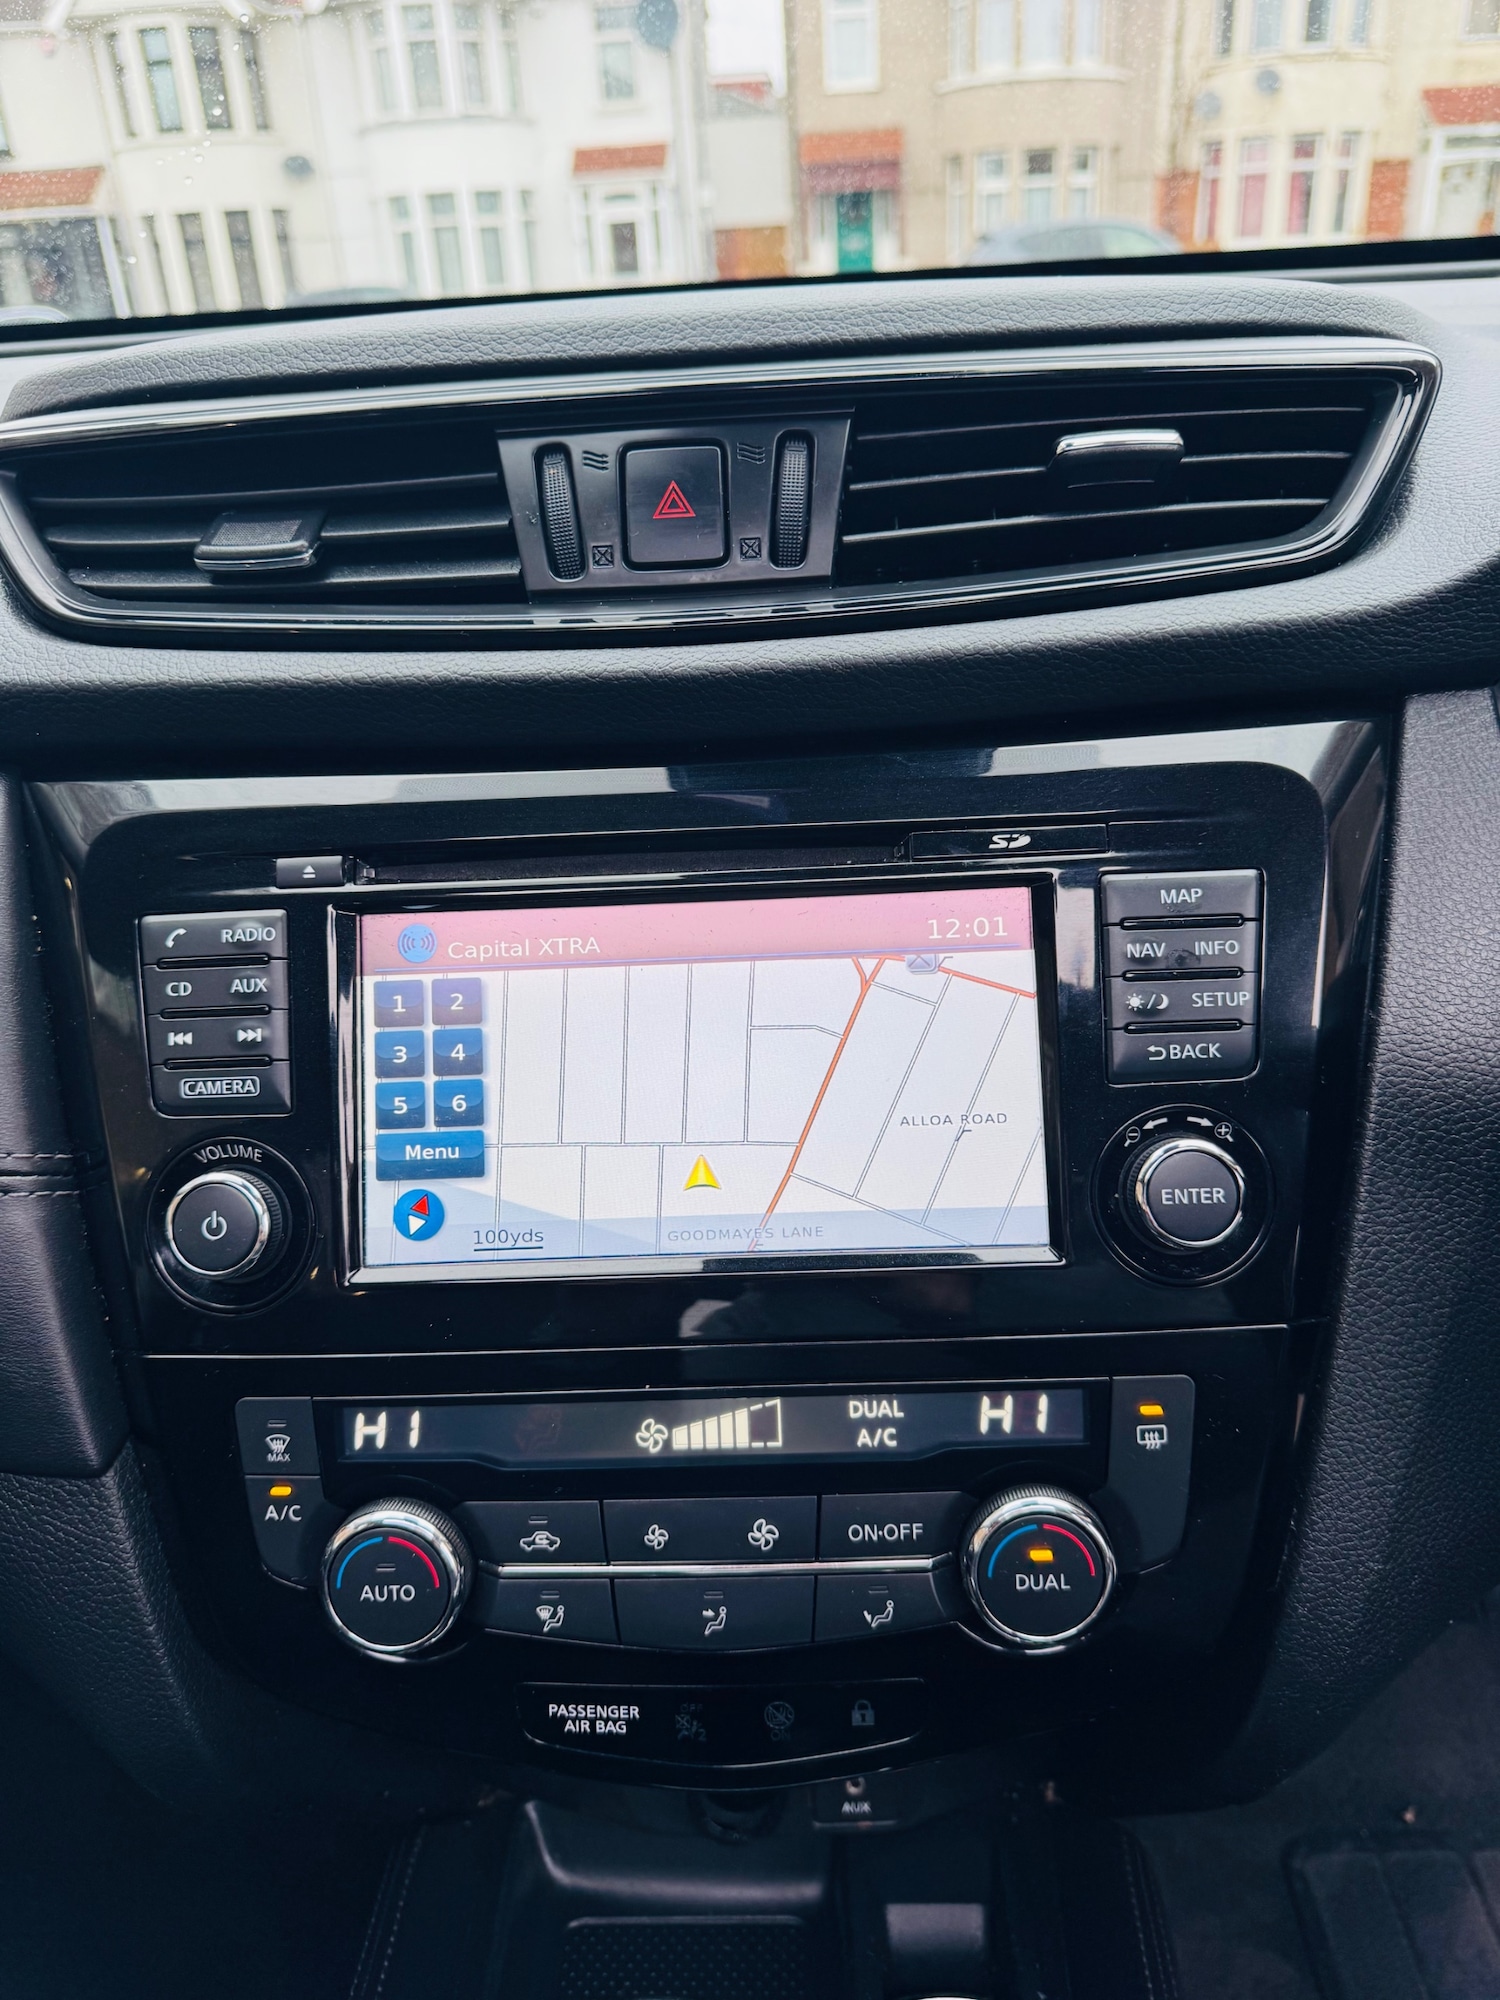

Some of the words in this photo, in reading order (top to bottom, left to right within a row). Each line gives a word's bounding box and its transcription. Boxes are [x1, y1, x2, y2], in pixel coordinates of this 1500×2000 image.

[988, 833, 1032, 850] SD
[1159, 887, 1203, 905] MAP
[220, 926, 277, 945] RADIO
[926, 916, 1009, 941] 12:01
[447, 940, 530, 964] Capital
[538, 936, 601, 957] XTRA
[1126, 940, 1167, 959] NAV
[1194, 938, 1240, 957] INFO
[165, 980, 193, 998] CD
[229, 977, 268, 994] AUX
[391, 996, 406, 1013] 1
[449, 993, 465, 1011] 2
[1191, 991, 1250, 1010] SETUP
[392, 1047, 408, 1064] 3
[450, 1044, 466, 1062] 4
[1169, 1041, 1222, 1060] BACK
[184, 1079, 256, 1096] CAMERA
[393, 1097, 408, 1115] 5
[451, 1095, 467, 1113] 6
[900, 1112, 954, 1128] ALLOA
[960, 1111, 1008, 1126] ROAD
[193, 1144, 264, 1165] VOLUME
[404, 1144, 461, 1161] Menu
[1160, 1187, 1226, 1205] ENTER
[472, 1228, 544, 1248] 100yds
[667, 1227, 774, 1242] GOODMAYES
[782, 1225, 825, 1238] LANE
[848, 1399, 905, 1420] DUAL
[856, 1428, 899, 1449] A/C
[267, 1452, 292, 1463] MAX
[264, 1503, 302, 1523] A/C
[1014, 1572, 1072, 1593] DUAL
[359, 1583, 416, 1603] AUTO
[548, 1703, 641, 1720] PASSENGER
[564, 1719, 592, 1734] AIR
[596, 1720, 628, 1735] BAG
[841, 1800, 872, 1815] AUX
